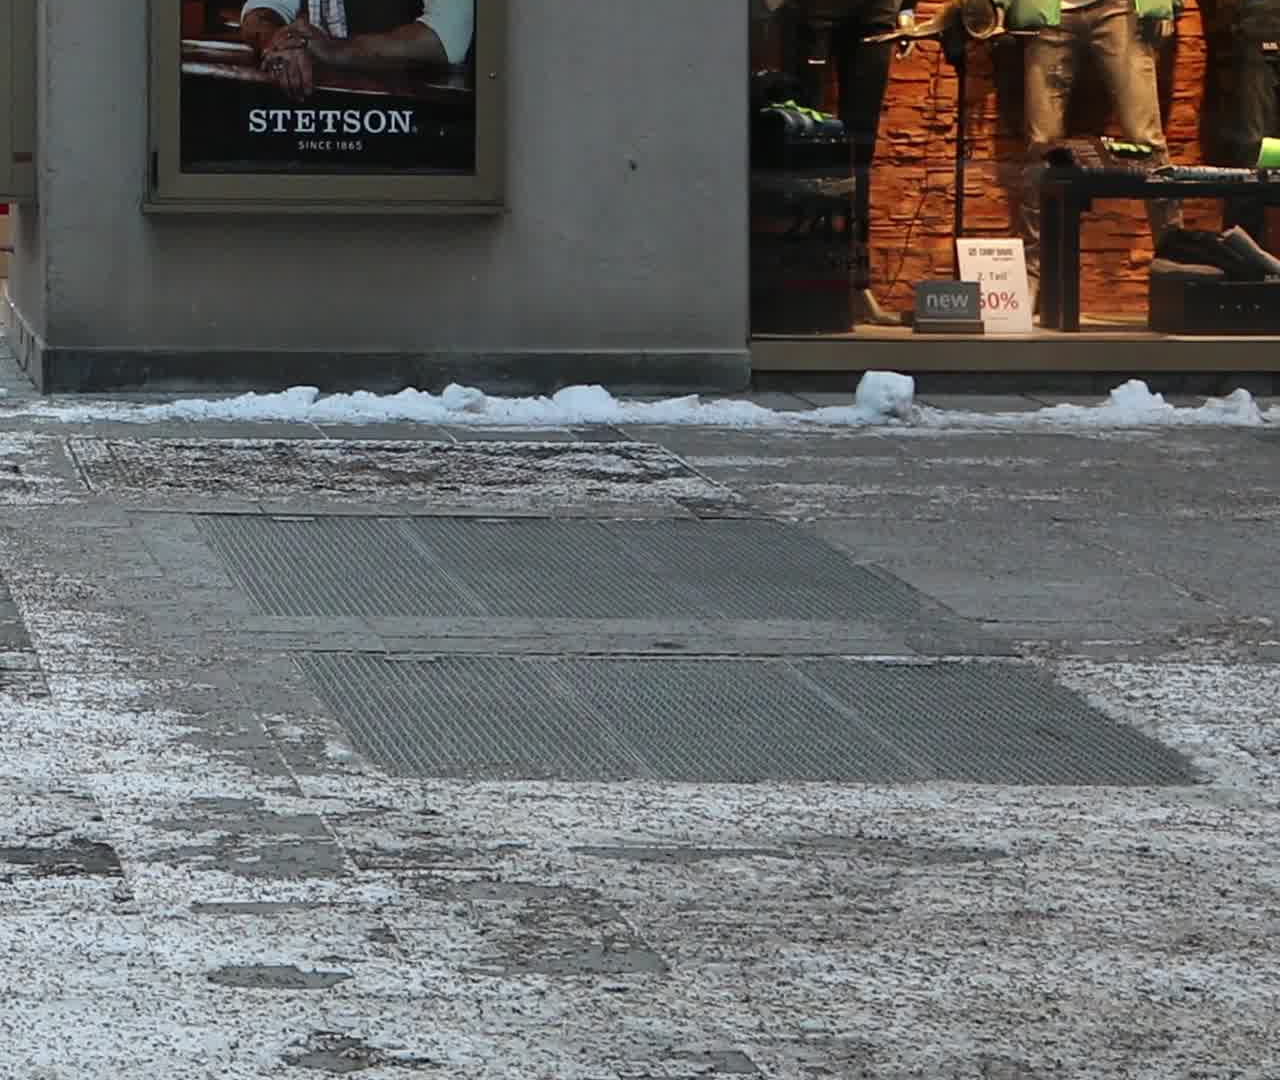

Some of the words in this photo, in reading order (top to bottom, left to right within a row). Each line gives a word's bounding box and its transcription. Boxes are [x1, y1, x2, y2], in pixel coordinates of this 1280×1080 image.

[248, 108, 413, 134] STETSON
[297, 140, 332, 151] SINCE
[336, 140, 364, 151] 1865
[926, 293, 969, 308] new
